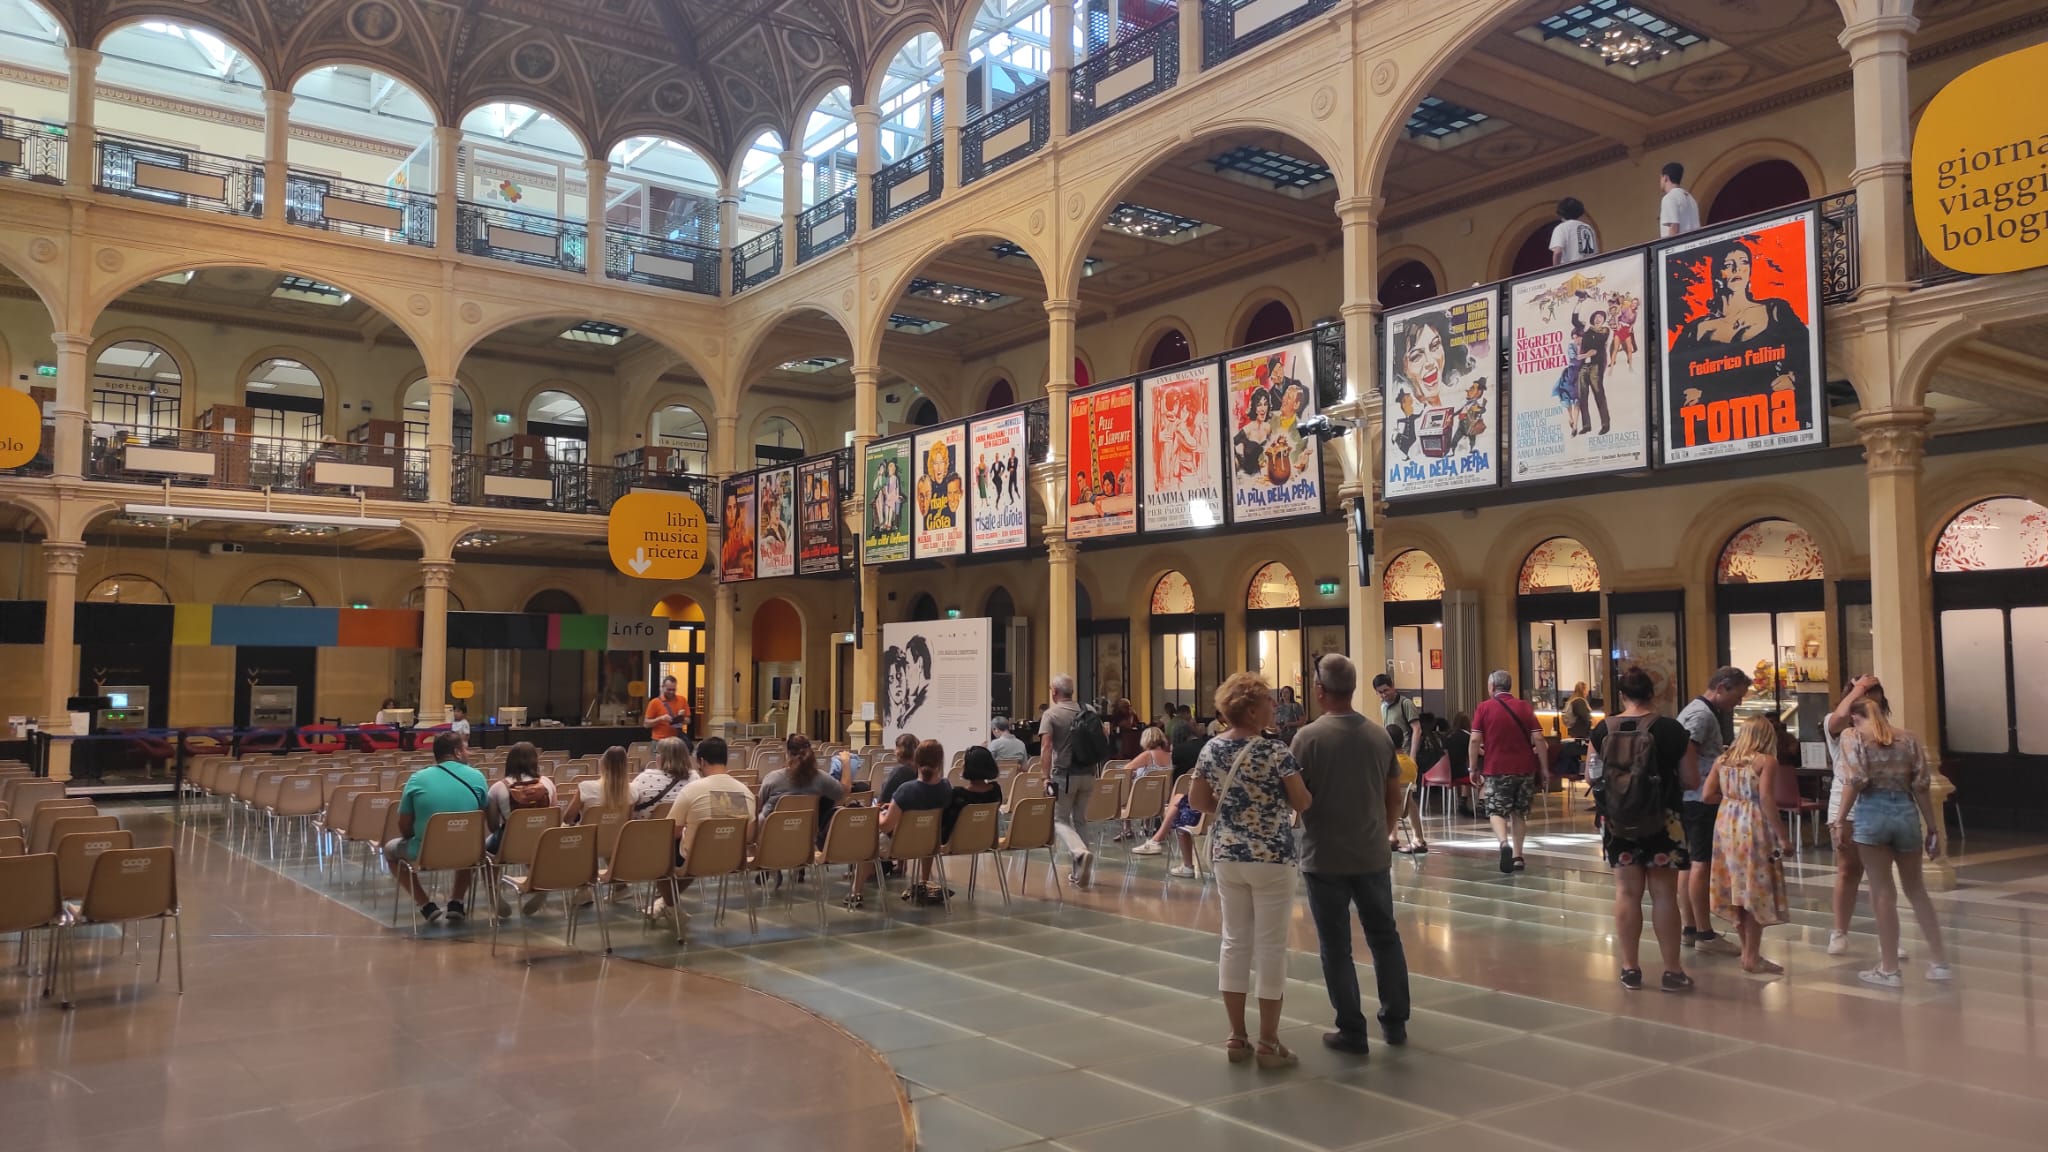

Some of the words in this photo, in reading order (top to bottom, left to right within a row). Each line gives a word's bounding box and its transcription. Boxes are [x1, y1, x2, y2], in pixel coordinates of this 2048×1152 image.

[1517, 327, 1526, 340] IL
[1517, 331, 1563, 351] SEGRETO
[1517, 350, 1528, 363] DI
[1530, 343, 1564, 361] SANTA
[1688, 354, 1742, 377] federico
[1744, 344, 1786, 366] fellini
[1517, 355, 1569, 376] VITTORIA
[105, 381, 169, 394] spettaclo
[1680, 389, 1801, 448] roma
[1389, 463, 1402, 483] LA
[1429, 455, 1458, 478] DELLA
[1460, 448, 1490, 473] PEPPA
[1147, 491, 1185, 506] MAMMA
[1188, 487, 1219, 502] ROMA
[1236, 488, 1246, 506] LA
[1267, 484, 1291, 503] DELLA
[1292, 478, 1317, 500] PEPPA
[667, 511, 699, 528] libri
[644, 528, 699, 544] musica
[647, 544, 699, 560] ricerca
[611, 621, 655, 637] info
[120, 858, 151, 869] coop
